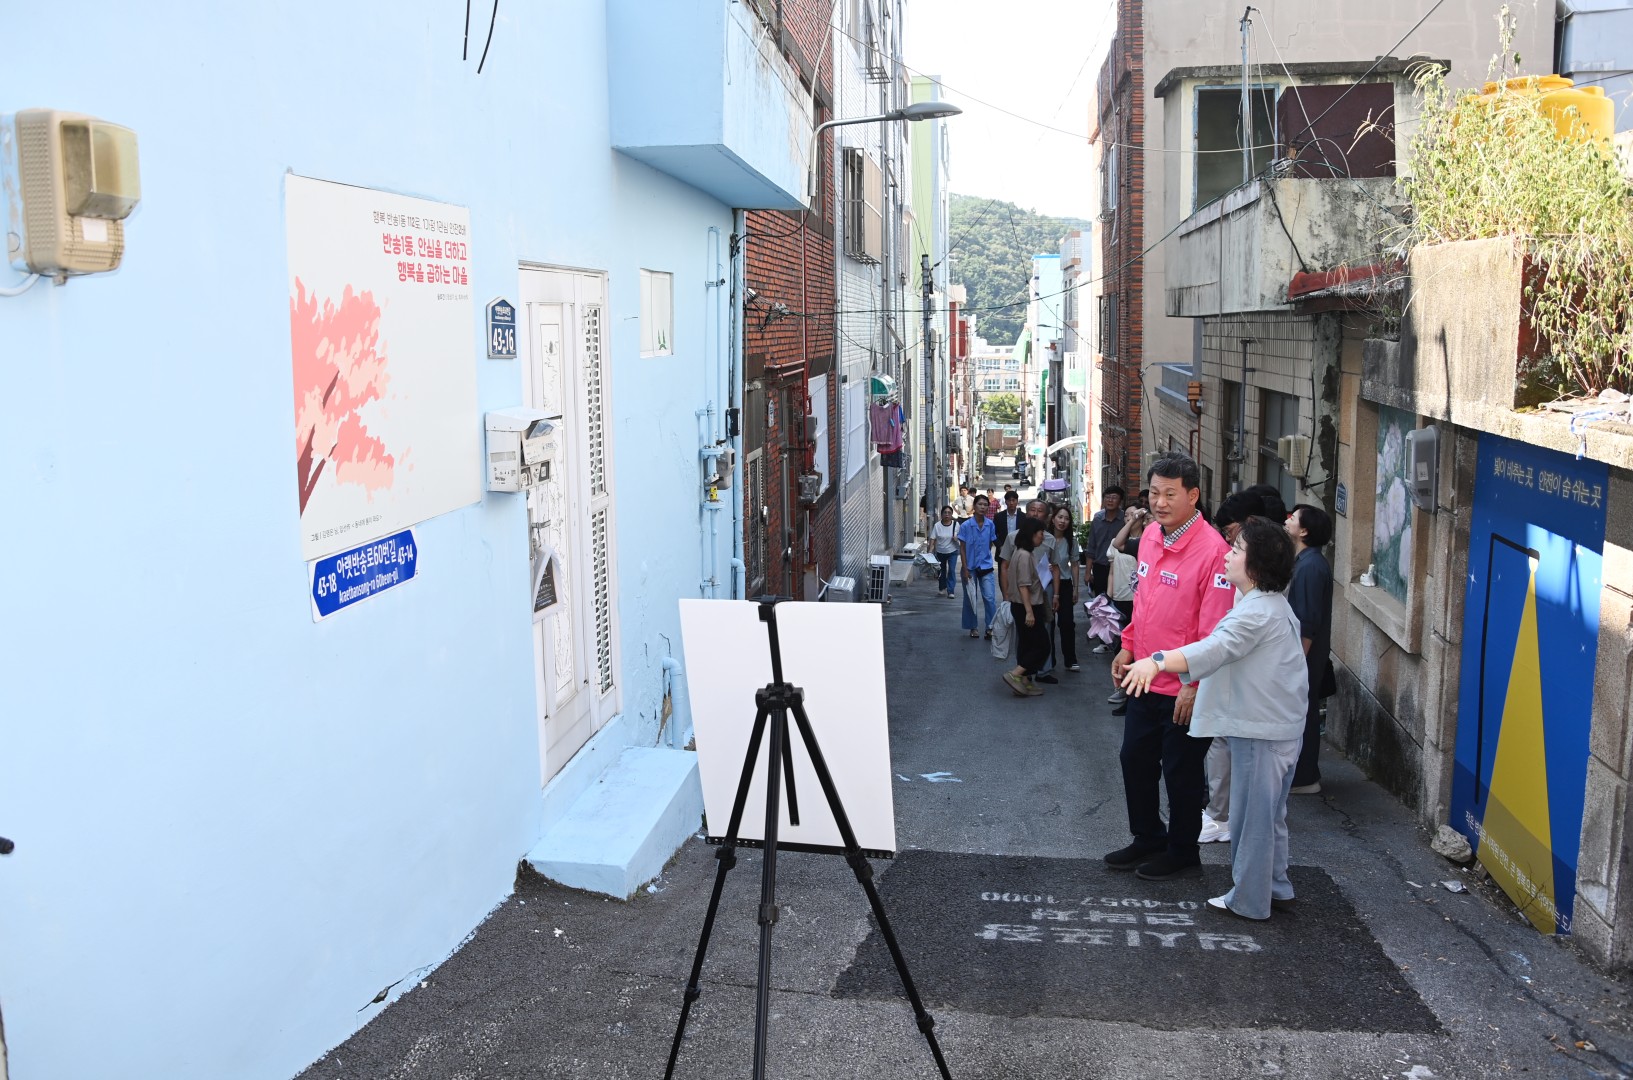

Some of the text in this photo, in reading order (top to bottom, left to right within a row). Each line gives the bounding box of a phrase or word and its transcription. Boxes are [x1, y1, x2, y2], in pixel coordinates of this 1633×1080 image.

[373, 211, 385, 224] 행복
[383, 233, 467, 261] 반송1동, 안심을 더하고
[398, 261, 467, 285] 행복을 곱하는 마을
[493, 328, 514, 351] 43-16
[1538, 471, 1562, 496] 안전이
[1572, 479, 1590, 505] 쉬는
[1590, 485, 1602, 509] 곳
[317, 538, 414, 598] 43-18 아랫반송로60번길 43-14
